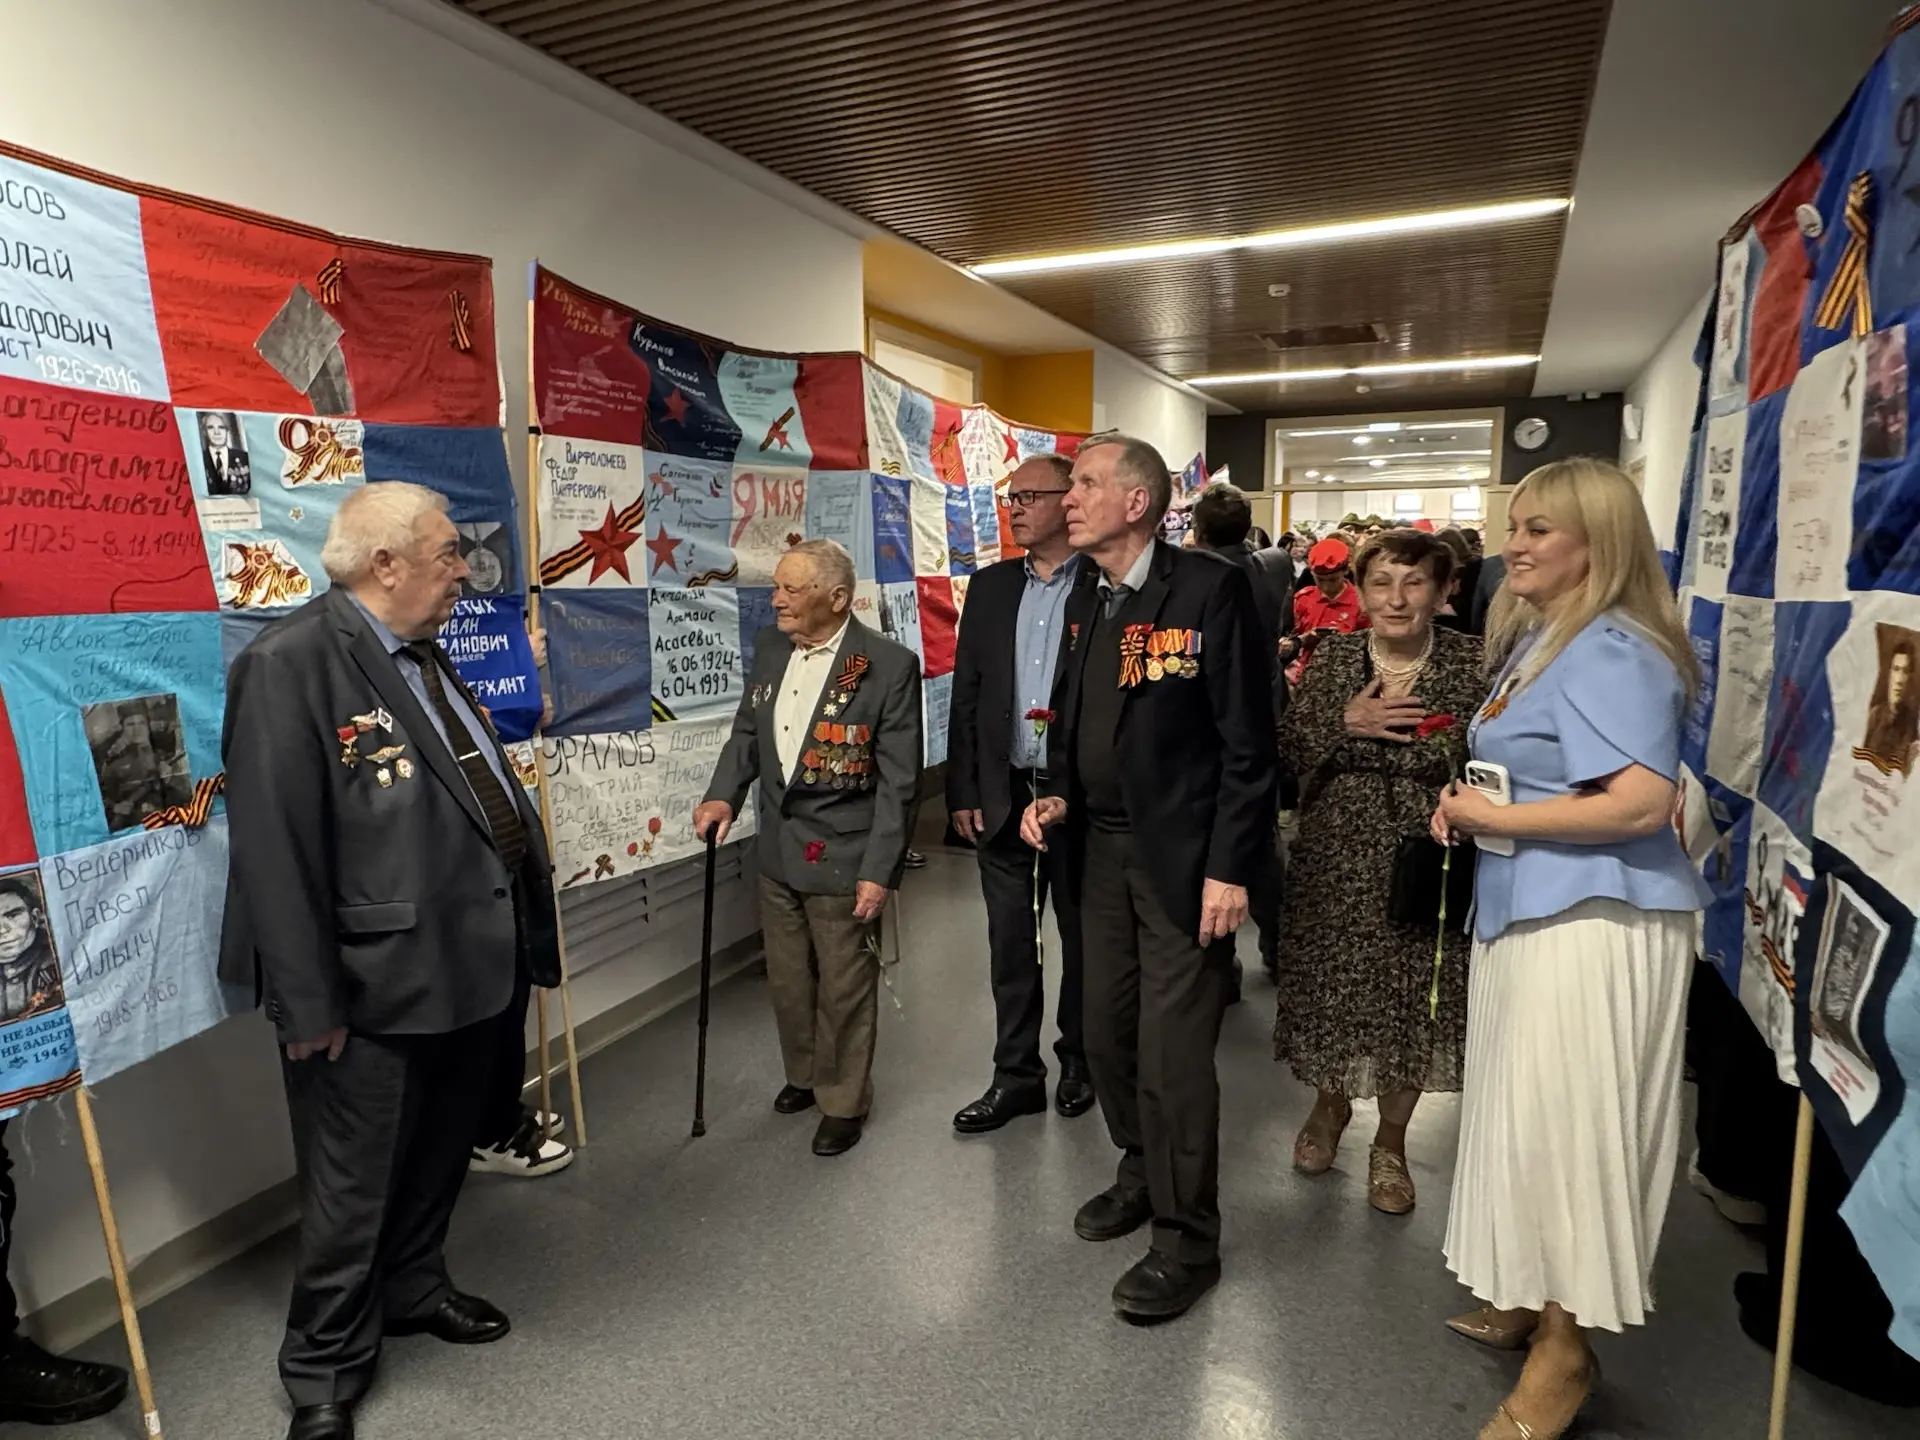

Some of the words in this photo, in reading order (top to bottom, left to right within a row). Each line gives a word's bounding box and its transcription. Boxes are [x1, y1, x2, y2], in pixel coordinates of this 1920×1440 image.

[0, 180, 66, 220] сов
[35, 353, 142, 395] 1926-2016
[438, 616, 480, 637] ИВАН
[542, 730, 656, 777] УРАЛОВ
[64, 885, 152, 937] Павел
[33, 1042, 68, 1064] 1945
